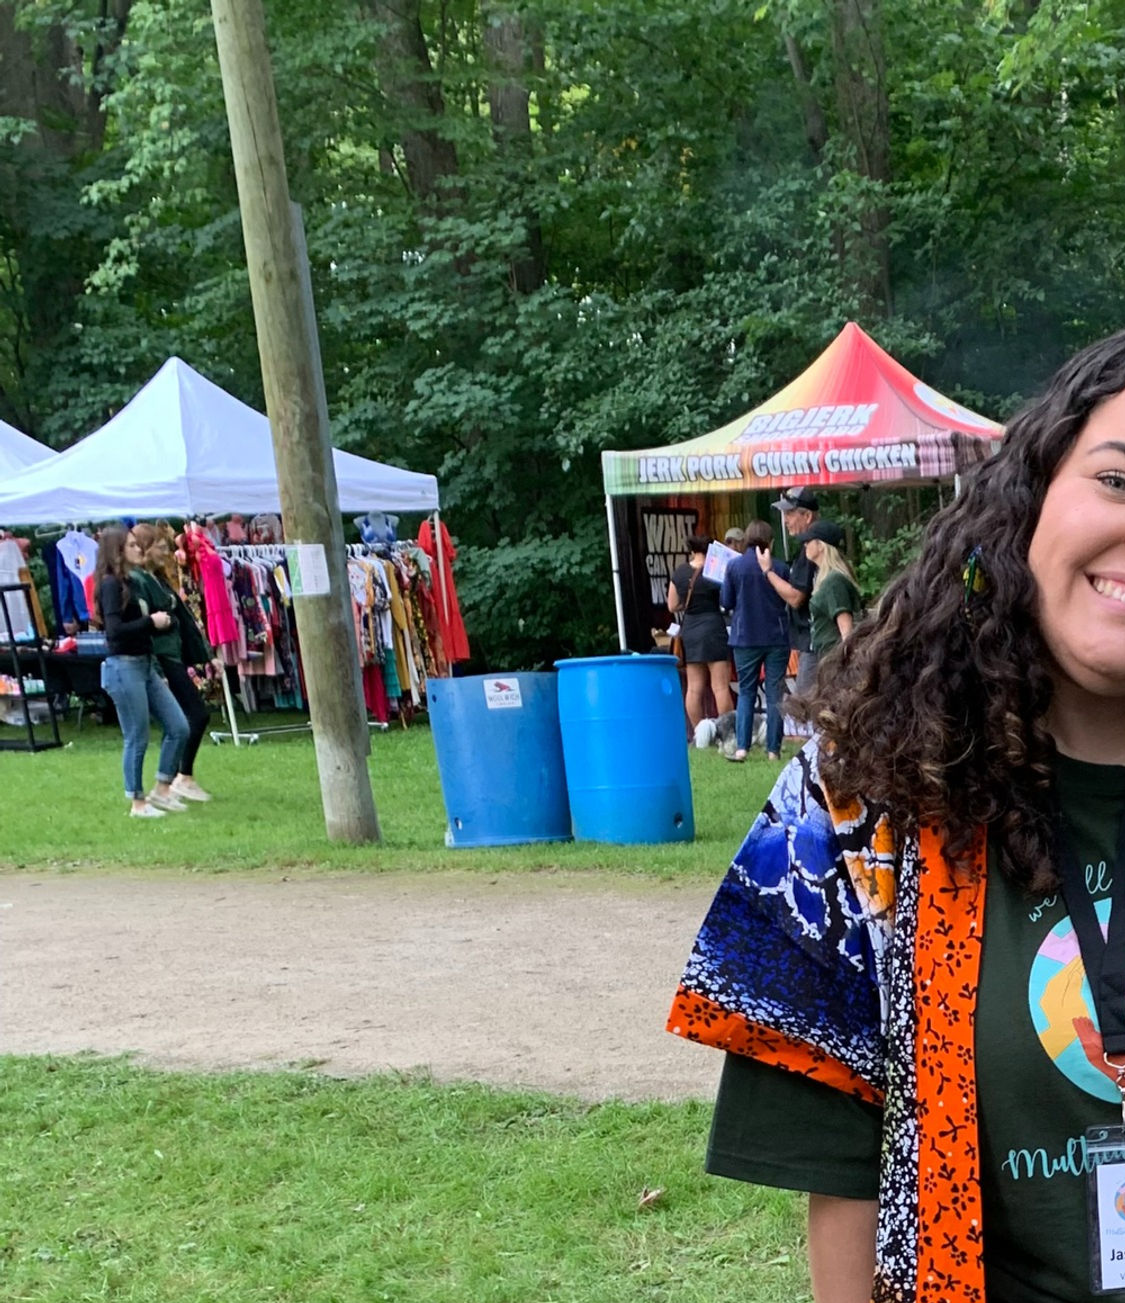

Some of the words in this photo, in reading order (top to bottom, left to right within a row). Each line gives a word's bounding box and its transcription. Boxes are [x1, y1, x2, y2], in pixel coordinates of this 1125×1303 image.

[638, 454, 686, 484] JERK
[686, 453, 743, 482] PORK
[752, 450, 822, 478] CURRY
[824, 443, 916, 473] CHICKEN
[643, 512, 696, 553] WHAT
[1028, 894, 1057, 923] we
[1085, 860, 1113, 895] ll
